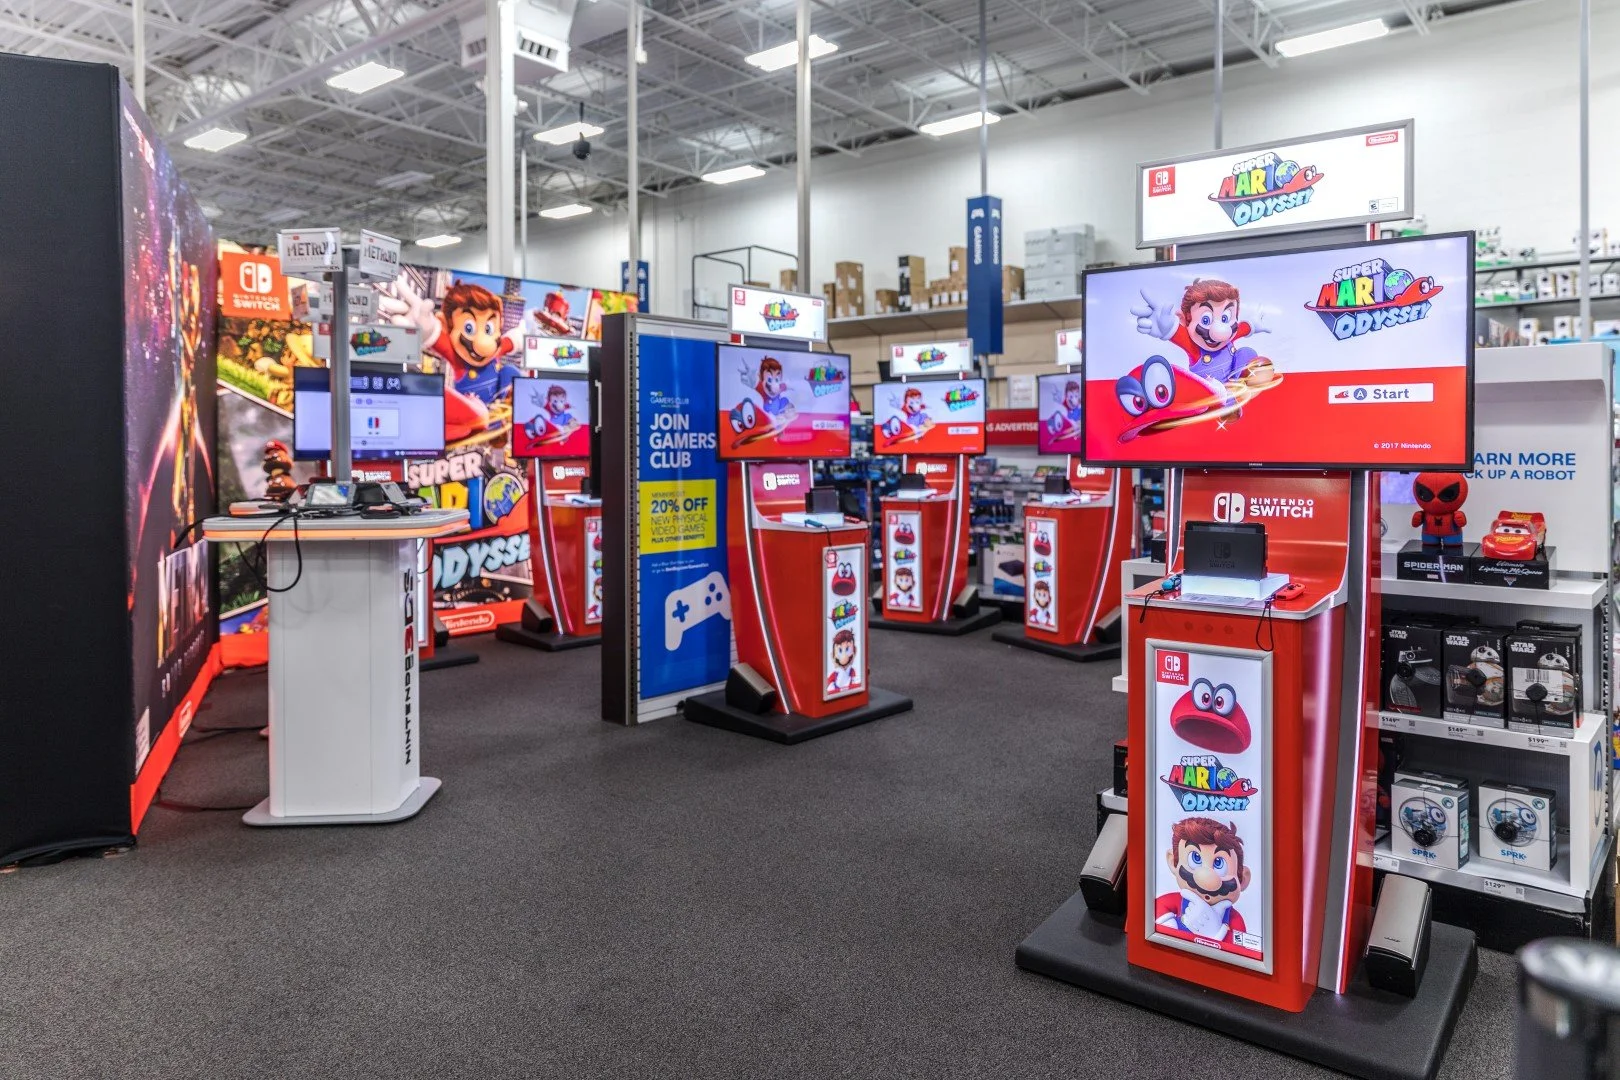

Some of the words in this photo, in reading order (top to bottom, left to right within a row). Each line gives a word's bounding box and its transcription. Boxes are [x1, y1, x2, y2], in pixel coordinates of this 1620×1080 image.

[1232, 152, 1276, 175] SUPER
[1219, 159, 1300, 198] MARIO
[1233, 187, 1314, 227] ODYSSEY
[287, 242, 337, 257] METROD
[1333, 258, 1384, 282] SUPER
[1316, 269, 1414, 307] MARIO
[232, 299, 281, 311] SWITCH
[1334, 302, 1432, 340] ODYSSEY
[1373, 388, 1409, 400] Start
[649, 413, 690, 430] JOIN
[995, 421, 1038, 432] ADVERTISE
[649, 432, 717, 450] GAMERS
[649, 451, 692, 469] CLUB
[1473, 453, 1512, 465] ARN
[1519, 453, 1576, 466] MORE
[408, 452, 484, 489] SUPER
[1463, 470, 1483, 479] CK
[1488, 470, 1506, 479] UP
[1510, 470, 1520, 480] A
[1524, 470, 1576, 480] ROBOT
[651, 499, 680, 514] 20%
[683, 497, 708, 512] OFF
[1250, 498, 1314, 506] NINTENDO
[1249, 505, 1314, 519] SWITCH
[651, 516, 670, 526] NEW
[672, 513, 708, 524] PHYSICAL
[651, 525, 676, 536] VIDEO
[678, 523, 705, 534] GAMES
[433, 534, 531, 590] DYSSE
[1404, 561, 1464, 571] SPIDERMAN
[1446, 639, 1470, 647] WARS
[1511, 641, 1535, 649] STAR
[1511, 645, 1537, 654] WARS
[1161, 673, 1184, 681] SWITCH
[405, 653, 414, 765] NINTENDO
[1181, 755, 1216, 767] SUPER
[1169, 765, 1238, 792] MARIO
[1182, 792, 1250, 812] ODYSSEY
[1196, 939, 1220, 949] Nintendo
